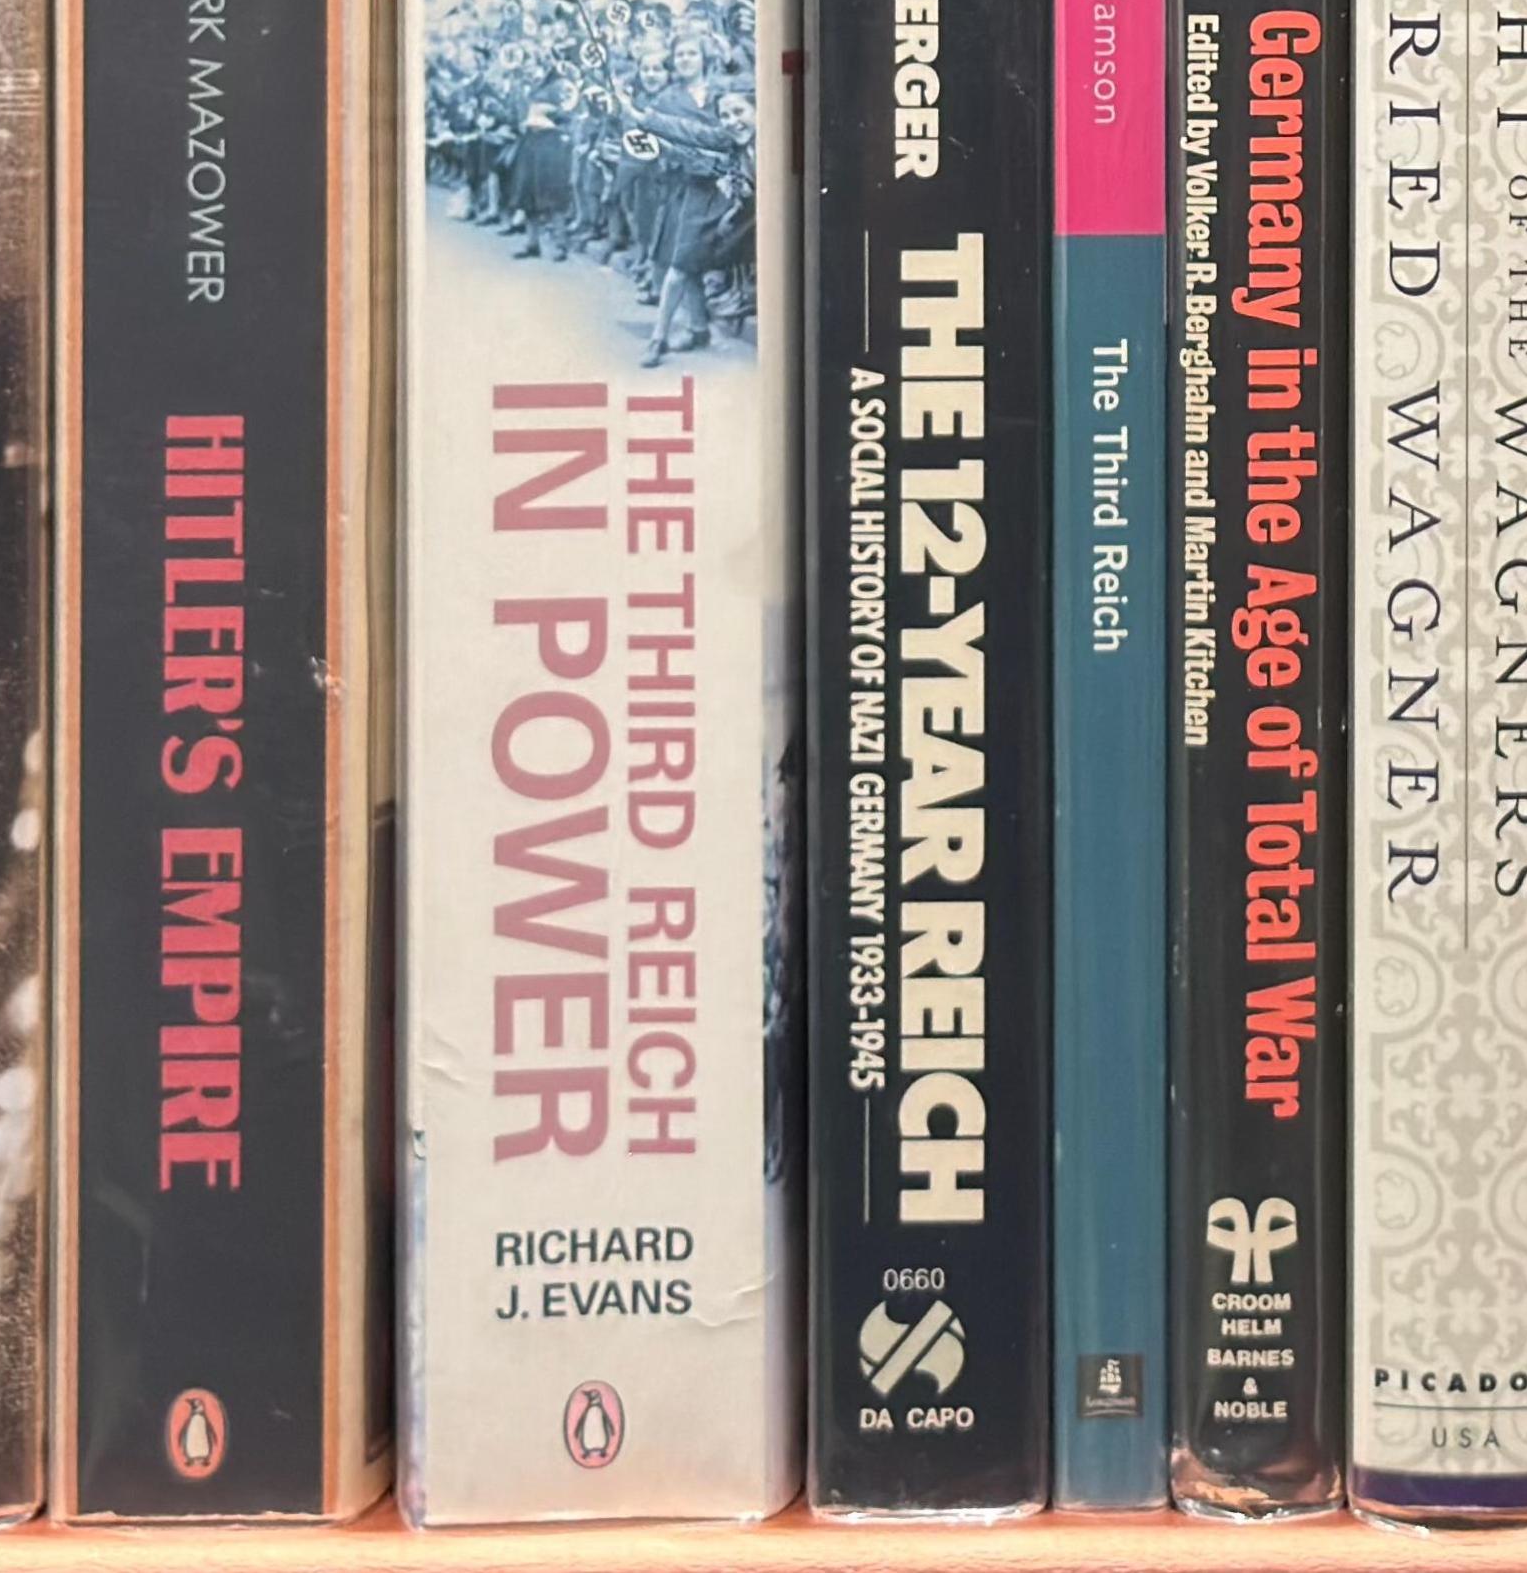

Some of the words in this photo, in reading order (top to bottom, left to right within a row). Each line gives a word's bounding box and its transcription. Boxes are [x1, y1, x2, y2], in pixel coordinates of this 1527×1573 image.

[1187, 14, 1220, 112] Edited
[186, 58, 227, 301] MAZOWER
[1184, 118, 1219, 156] by
[1232, 10, 1321, 329] Germany
[1185, 162, 1219, 259] Volker
[850, 368, 885, 392] A
[900, 234, 985, 440] THE
[1093, 338, 1127, 410] The
[1179, 295, 1217, 444] Berghahn
[1248, 348, 1317, 409] in
[493, 382, 608, 532] IN
[626, 376, 695, 553] THE
[849, 397, 886, 507] SOCIAL
[1093, 426, 1127, 527] Third
[1184, 449, 1216, 509] and
[1248, 425, 1317, 545] the
[161, 416, 244, 793] HITLER'S
[849, 511, 886, 640] HISTORY
[1093, 543, 1127, 651] Reich
[1185, 517, 1217, 621] Martin
[850, 649, 886, 685] OF
[899, 458, 988, 886] 12-YEAR
[1231, 564, 1317, 687] Age
[1387, 381, 1440, 903] WAGNER
[626, 573, 695, 850] THIRD
[850, 694, 886, 763] NAZI
[1184, 628, 1215, 746] Kitchen
[1246, 706, 1317, 778] of
[491, 596, 611, 1162] POWER
[849, 771, 886, 921] GERMANY
[1247, 791, 1317, 961] Total
[160, 827, 244, 1192] EMPIRE
[628, 886, 697, 1154] REICH
[849, 935, 886, 1090] 1933-1945
[899, 900, 984, 1221] REICH
[1246, 975, 1317, 1120] War
[493, 1228, 693, 1268] RICHARD
[495, 1282, 532, 1319] J.
[540, 1280, 693, 1319] EVANS
[881, 1268, 944, 1292] 0660
[1211, 1293, 1292, 1311] CROOM
[1206, 1349, 1294, 1368] BARNES
[1222, 1319, 1282, 1336] HELM
[860, 1407, 893, 1428] DA
[906, 1407, 974, 1428] CAPO
[1214, 1402, 1287, 1420] NOBLE
[1243, 1377, 1258, 1396] &
[1431, 1427, 1502, 1448] USA
